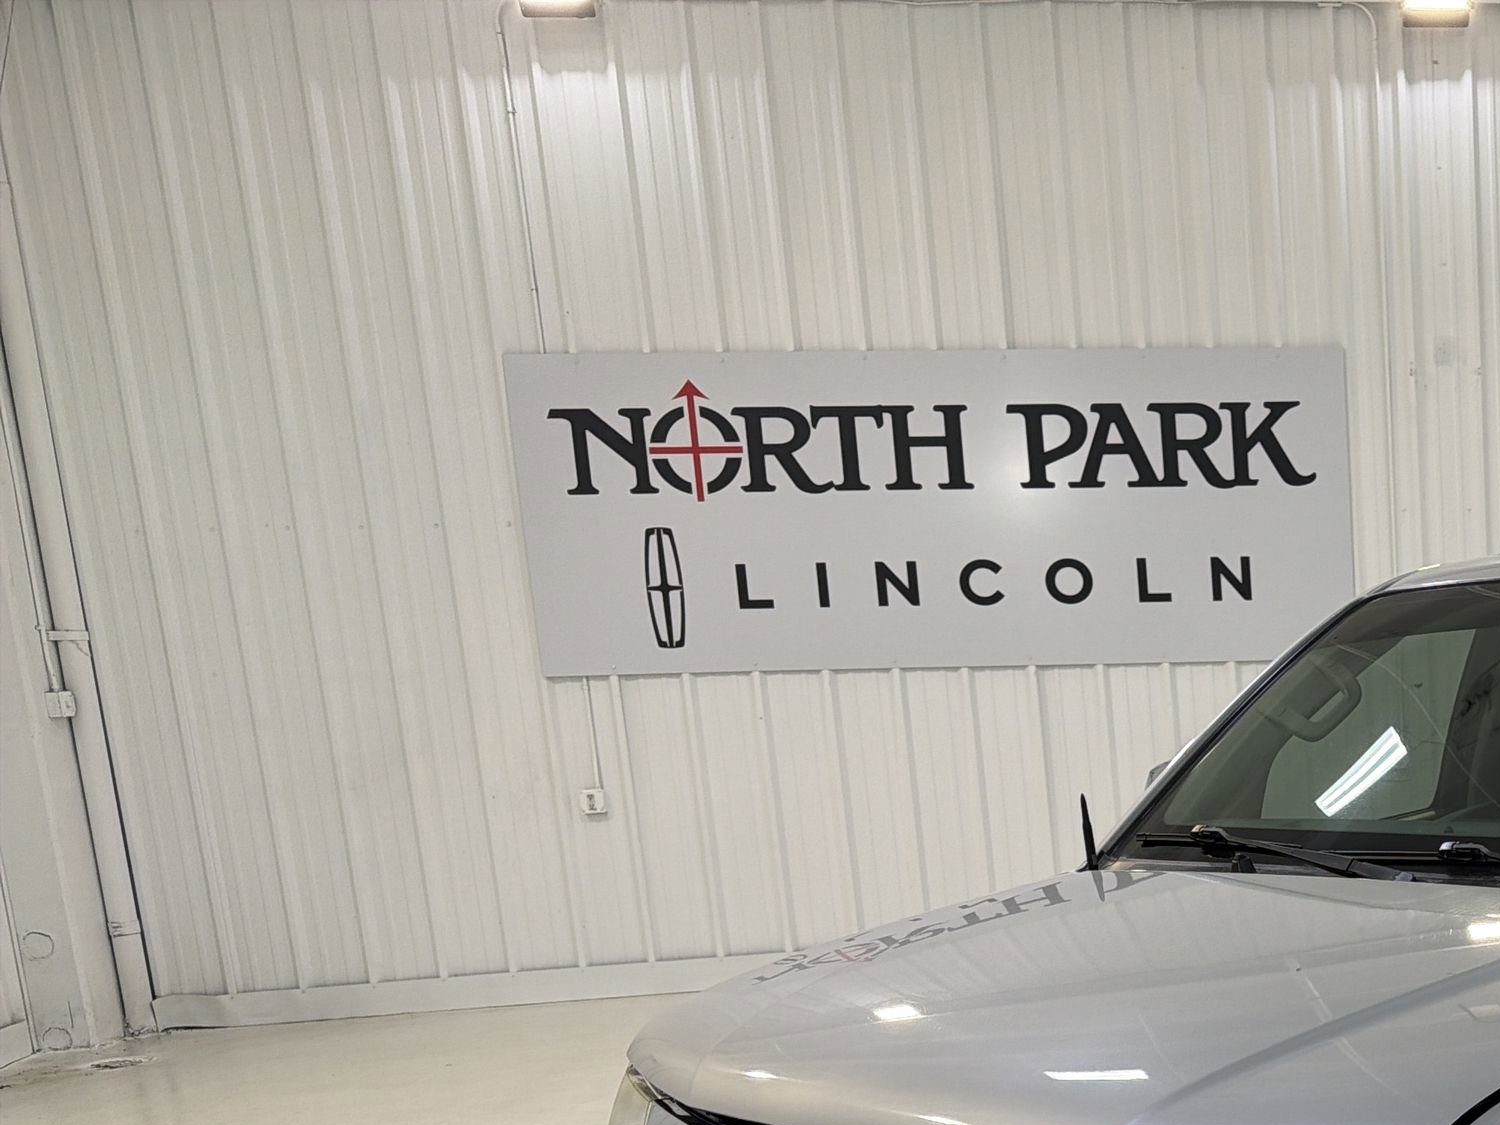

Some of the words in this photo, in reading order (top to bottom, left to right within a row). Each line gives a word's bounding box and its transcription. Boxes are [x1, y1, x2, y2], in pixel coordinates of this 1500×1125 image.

[546, 401, 976, 495] NORTH
[1006, 400, 1317, 489] PARK
[735, 555, 1254, 611] LINCOLN
